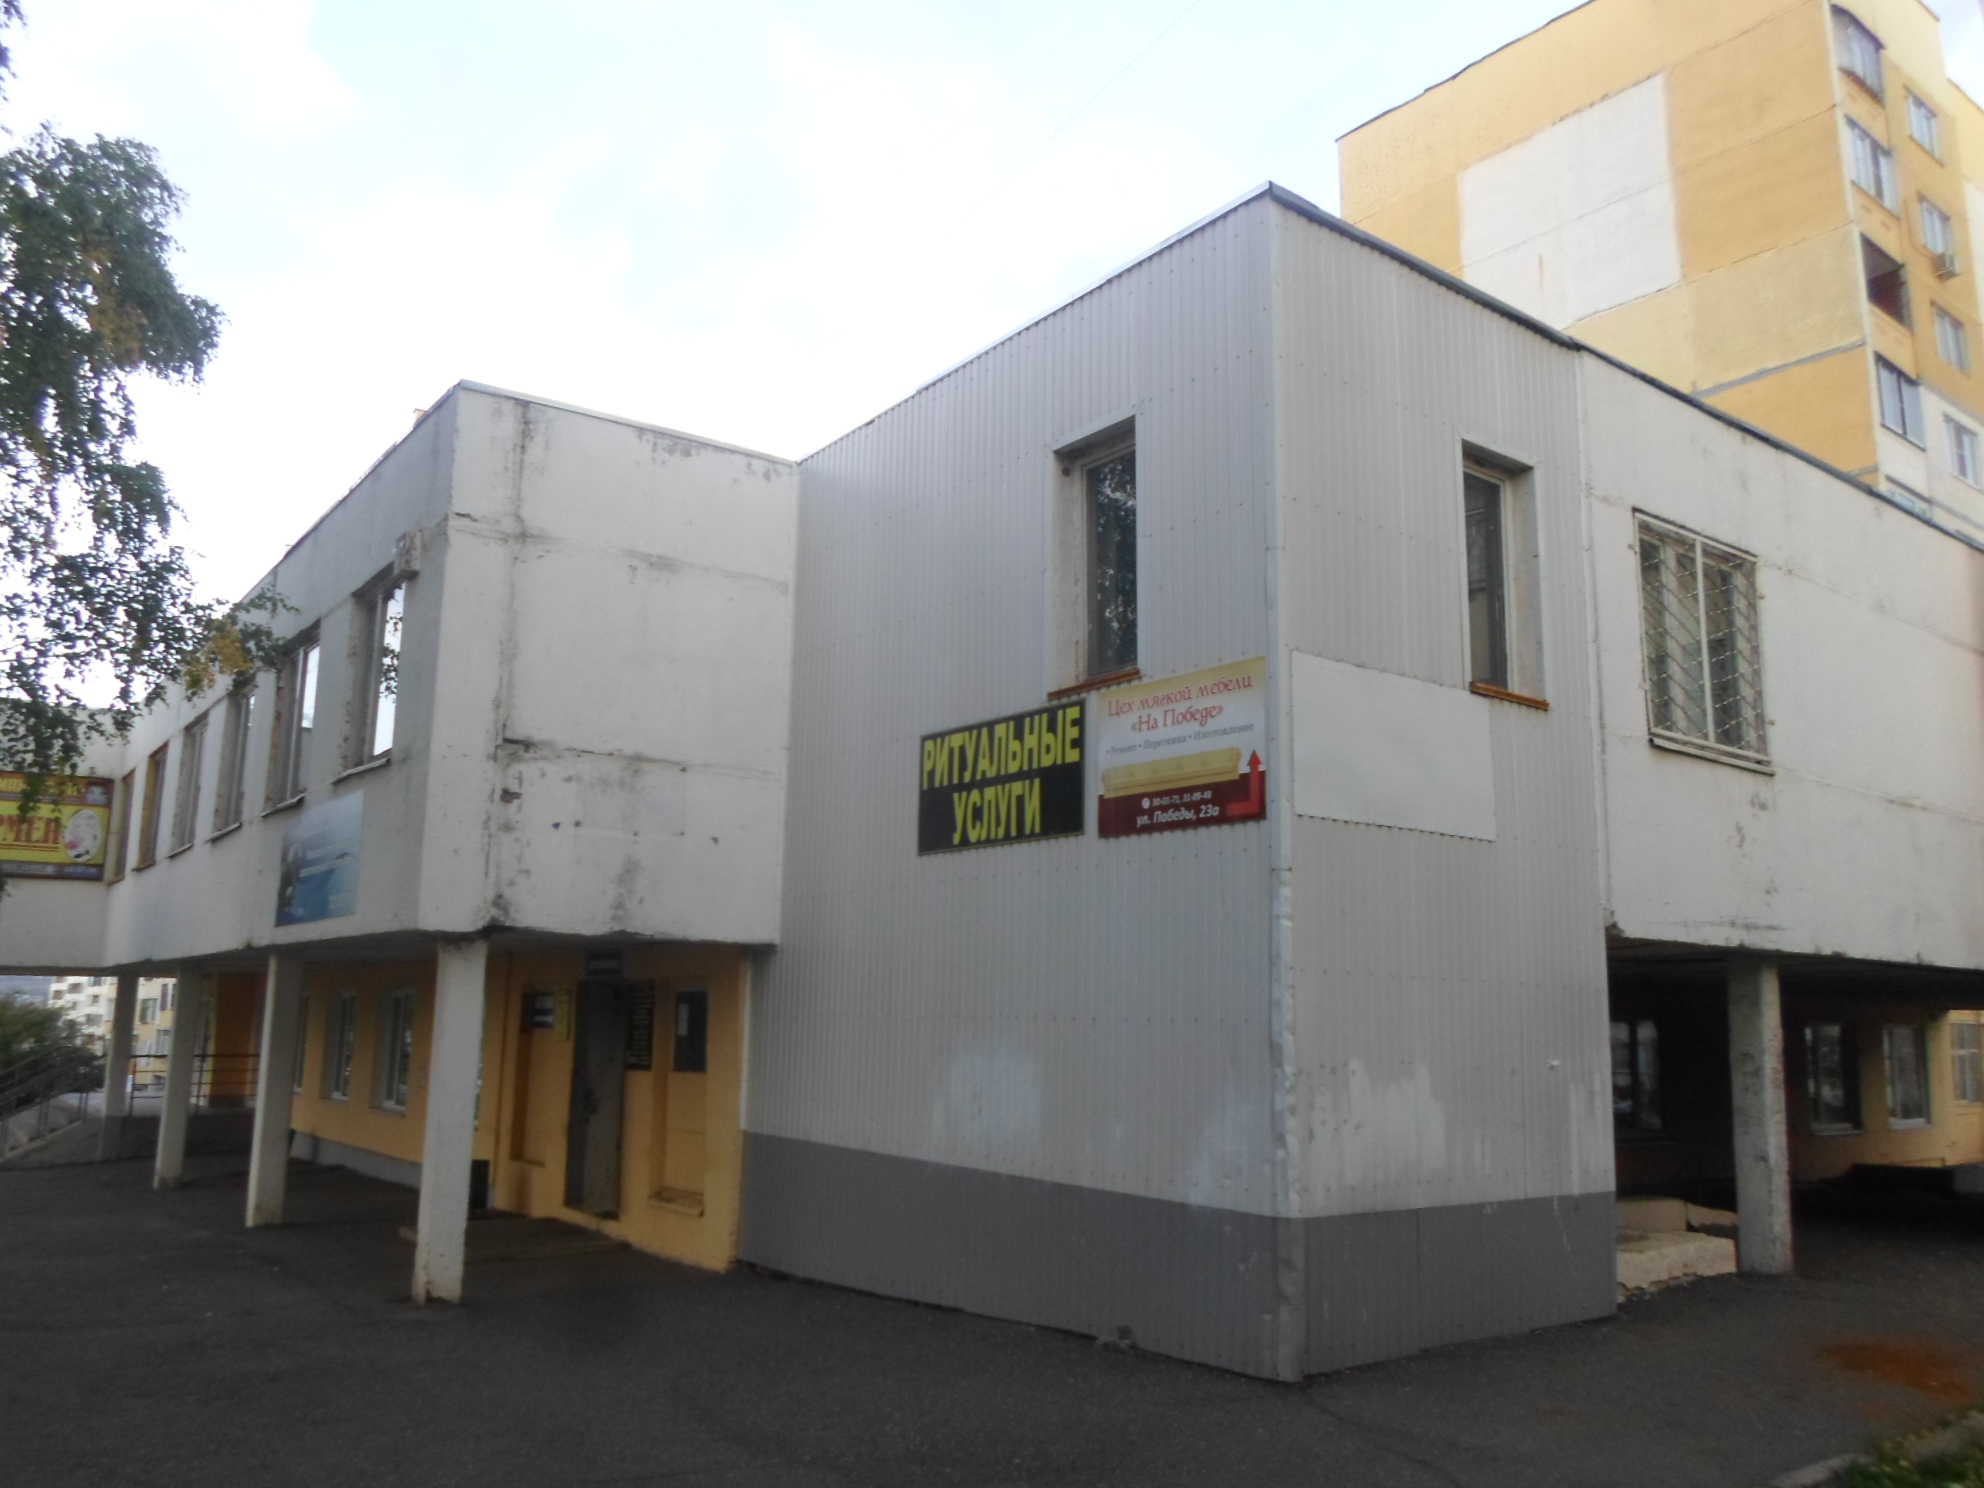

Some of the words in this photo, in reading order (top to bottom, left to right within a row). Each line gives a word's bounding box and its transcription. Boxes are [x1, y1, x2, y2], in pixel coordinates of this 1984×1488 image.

[1108, 697, 1134, 717] Цех
[1138, 686, 1192, 710] мягкой
[1196, 675, 1252, 698] мебели
[923, 706, 1080, 790] РИТУАЛЬНЫЕ
[953, 778, 1041, 845] УСЛУГИ
[1136, 814, 1151, 828] ул.
[1153, 806, 1196, 824] Победы,
[1199, 804, 1220, 818] 23а
